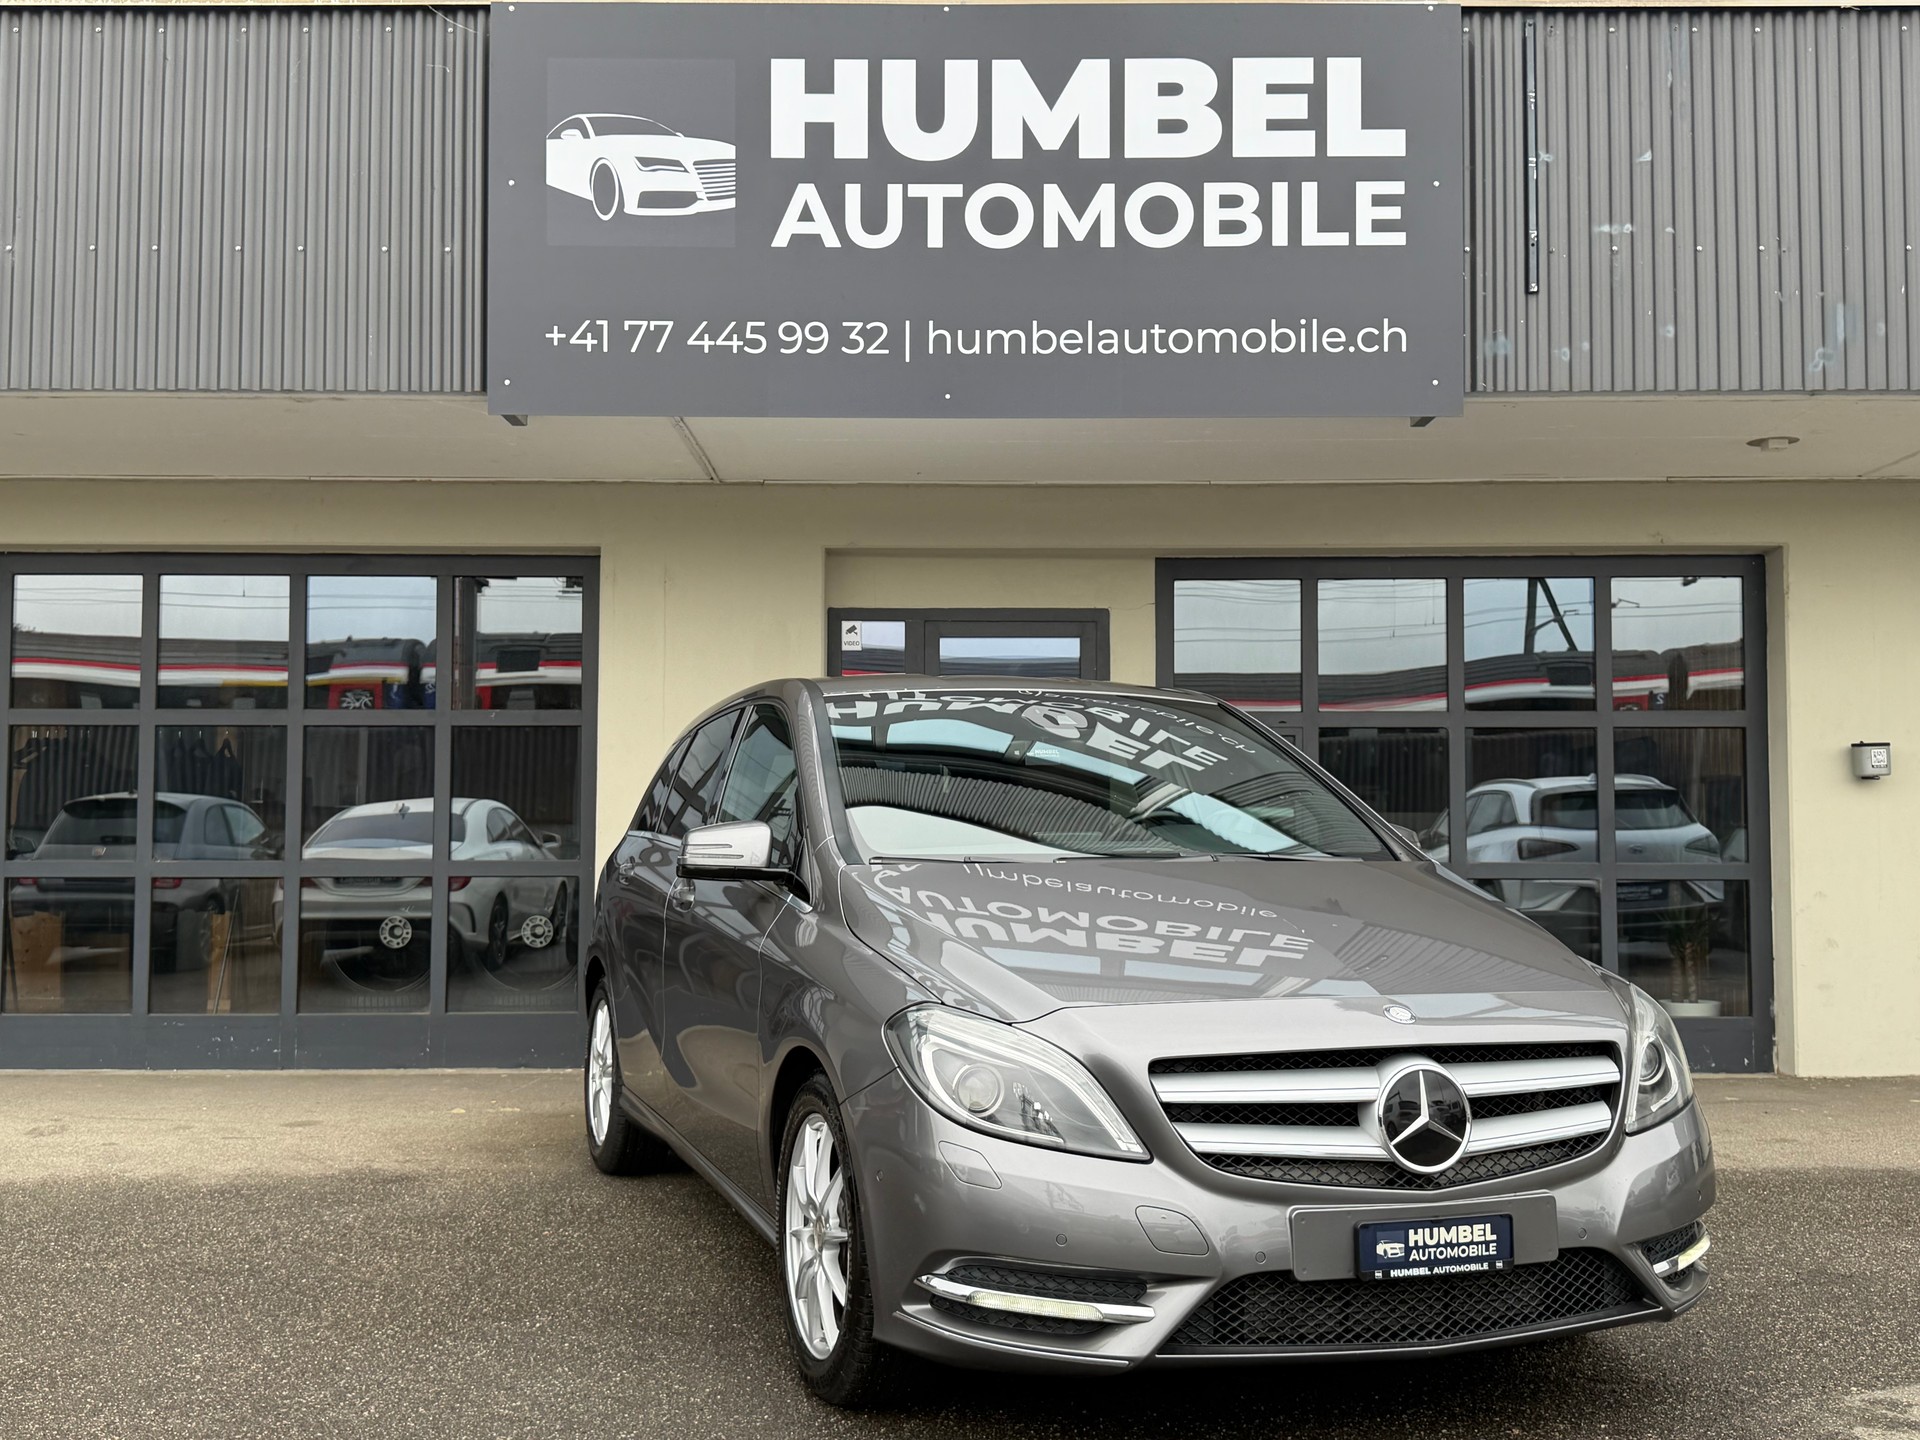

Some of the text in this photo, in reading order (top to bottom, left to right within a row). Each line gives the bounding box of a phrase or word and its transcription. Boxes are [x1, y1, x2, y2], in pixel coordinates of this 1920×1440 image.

[770, 56, 1407, 162] HUMBEL
[770, 180, 1407, 250] AUTOMOBILE
[545, 319, 609, 353] +41
[623, 320, 674, 353] 77
[686, 320, 767, 354] 445
[777, 320, 829, 355] 99
[840, 321, 890, 355] 32
[928, 317, 1407, 355] humbelautomobile.ch
[1408, 1223, 1497, 1247] HUMBEL
[1408, 1243, 1497, 1261] AUTOMOBILE
[1390, 1262, 1489, 1278] HUMBEL AUTOMOBILE
